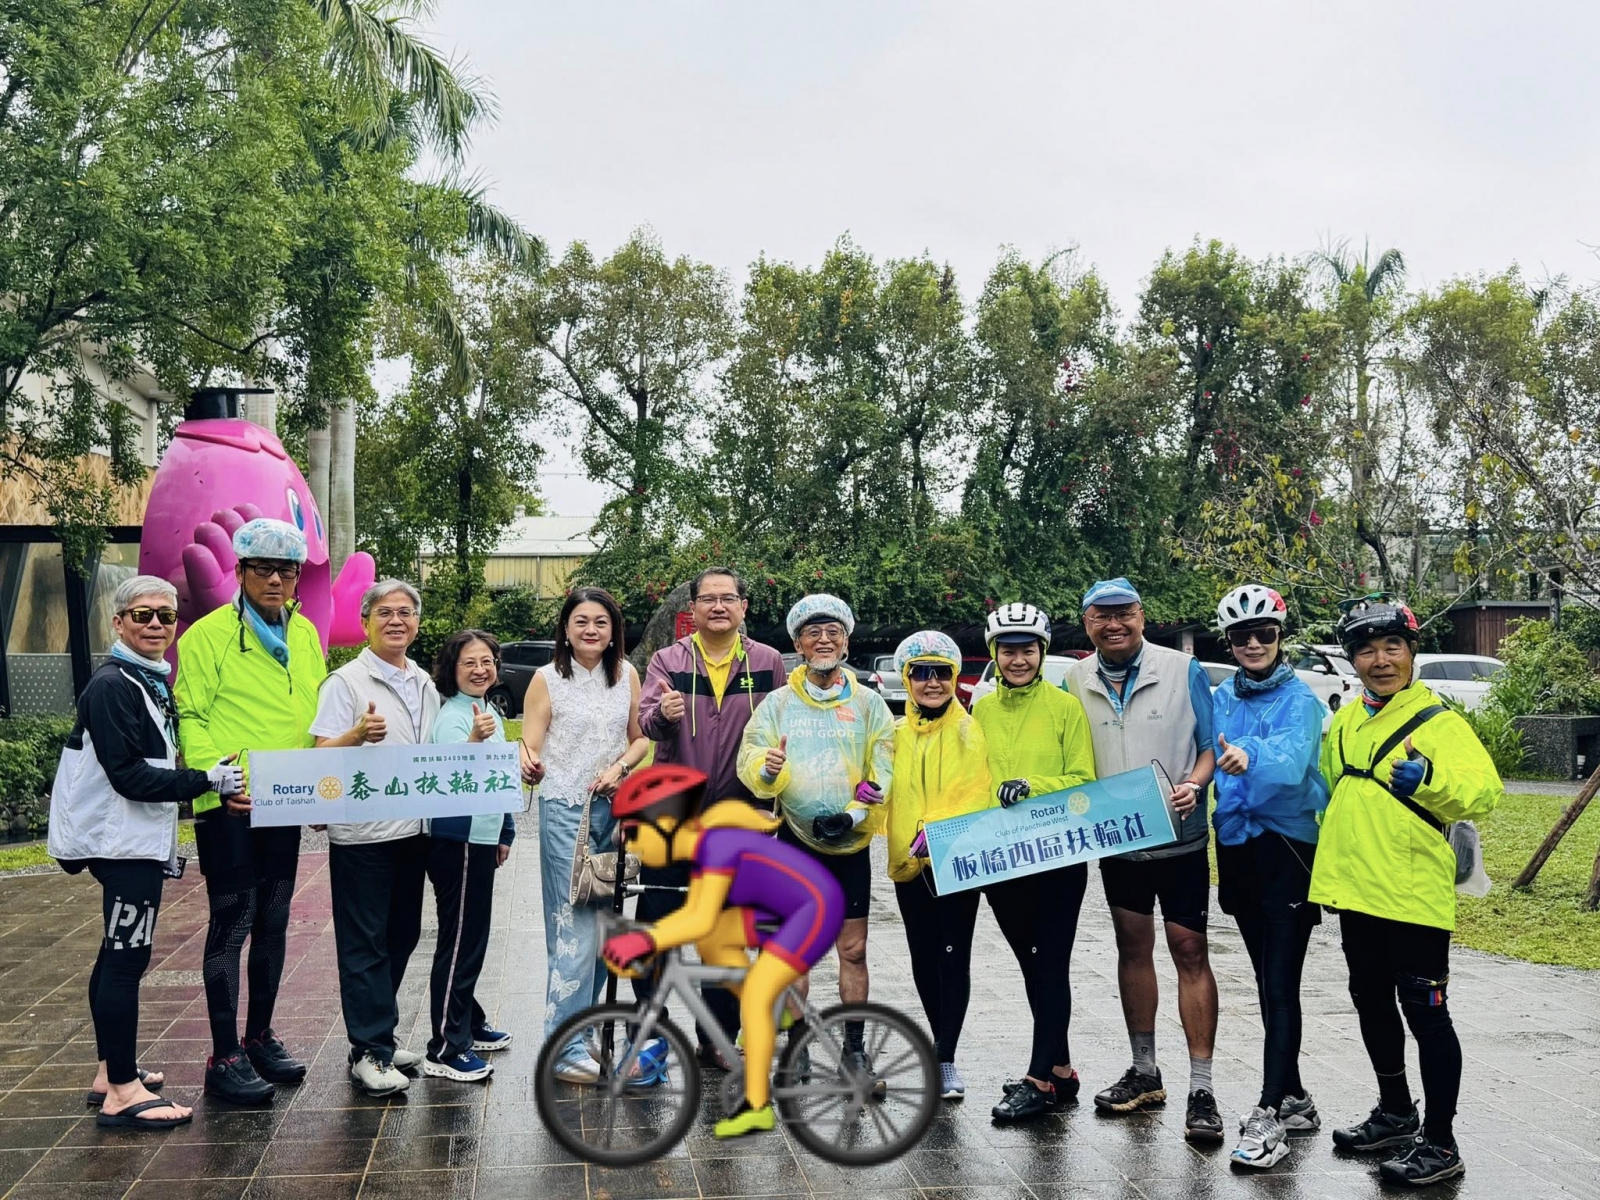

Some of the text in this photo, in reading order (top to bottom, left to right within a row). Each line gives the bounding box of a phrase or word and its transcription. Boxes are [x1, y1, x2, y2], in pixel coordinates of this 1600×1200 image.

[789, 718, 826, 728] UNITE
[789, 729, 855, 738] FOR GOOD
[273, 784, 315, 796] Rotary
[346, 769, 517, 801] 泰山扶輪社
[254, 797, 316, 806] Club of Taishan
[1030, 804, 1066, 819] Rotary
[578, 823, 587, 845] LOUIS
[994, 815, 1069, 838] Club of Panchiao West
[951, 812, 1153, 882] 板橋西區扶輪社
